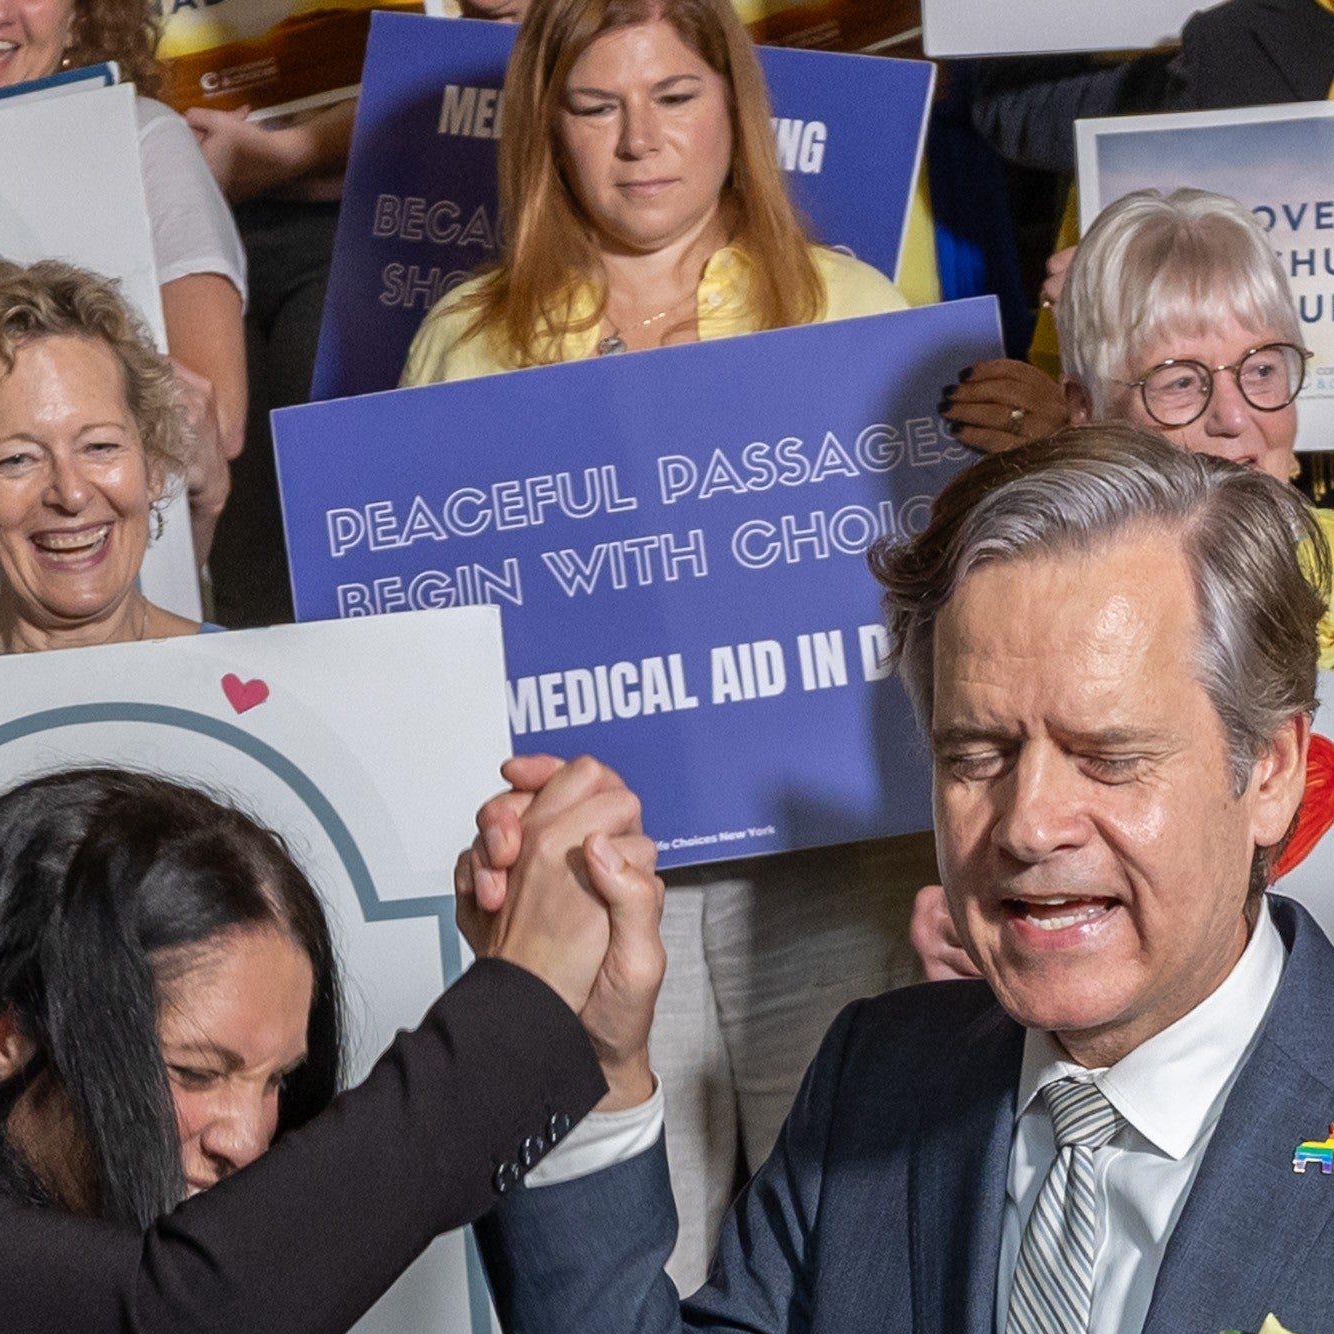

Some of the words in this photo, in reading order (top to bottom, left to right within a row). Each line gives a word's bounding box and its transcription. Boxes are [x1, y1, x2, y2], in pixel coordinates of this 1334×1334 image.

[437, 84, 505, 139] ME
[769, 117, 827, 174] NG
[373, 194, 507, 248] BECA
[326, 464, 638, 558] PEACEFUL
[540, 528, 709, 598] WITH
[506, 653, 699, 736] MEDICAL
[710, 639, 787, 705] AID
[796, 629, 849, 692] IN
[718, 830, 747, 842] New
[747, 825, 776, 838] York
